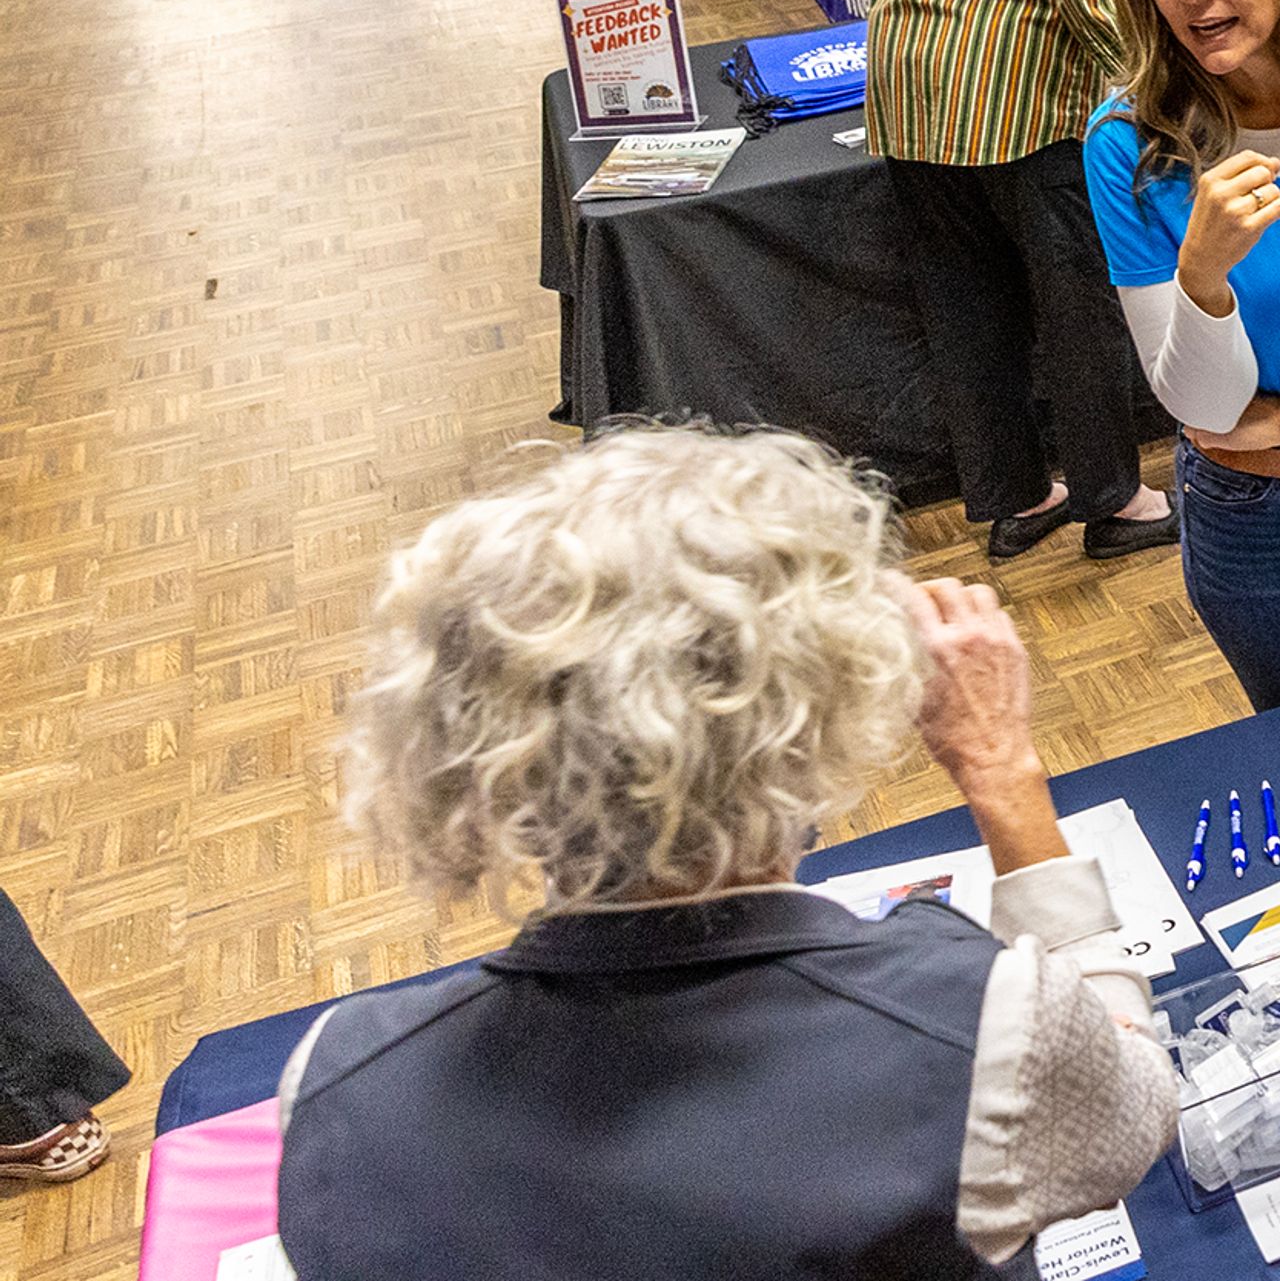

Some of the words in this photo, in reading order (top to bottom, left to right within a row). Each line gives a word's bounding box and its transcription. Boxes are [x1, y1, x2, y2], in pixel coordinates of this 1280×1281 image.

[576, 3, 662, 39] FEEDBACK
[590, 23, 662, 54] WANTED
[792, 56, 867, 82] LIBRA
[642, 99, 678, 110] LIBRARY
[619, 138, 732, 150] LEWISTON
[1068, 1235, 1126, 1261] Warrior
[1040, 1257, 1063, 1270] He
